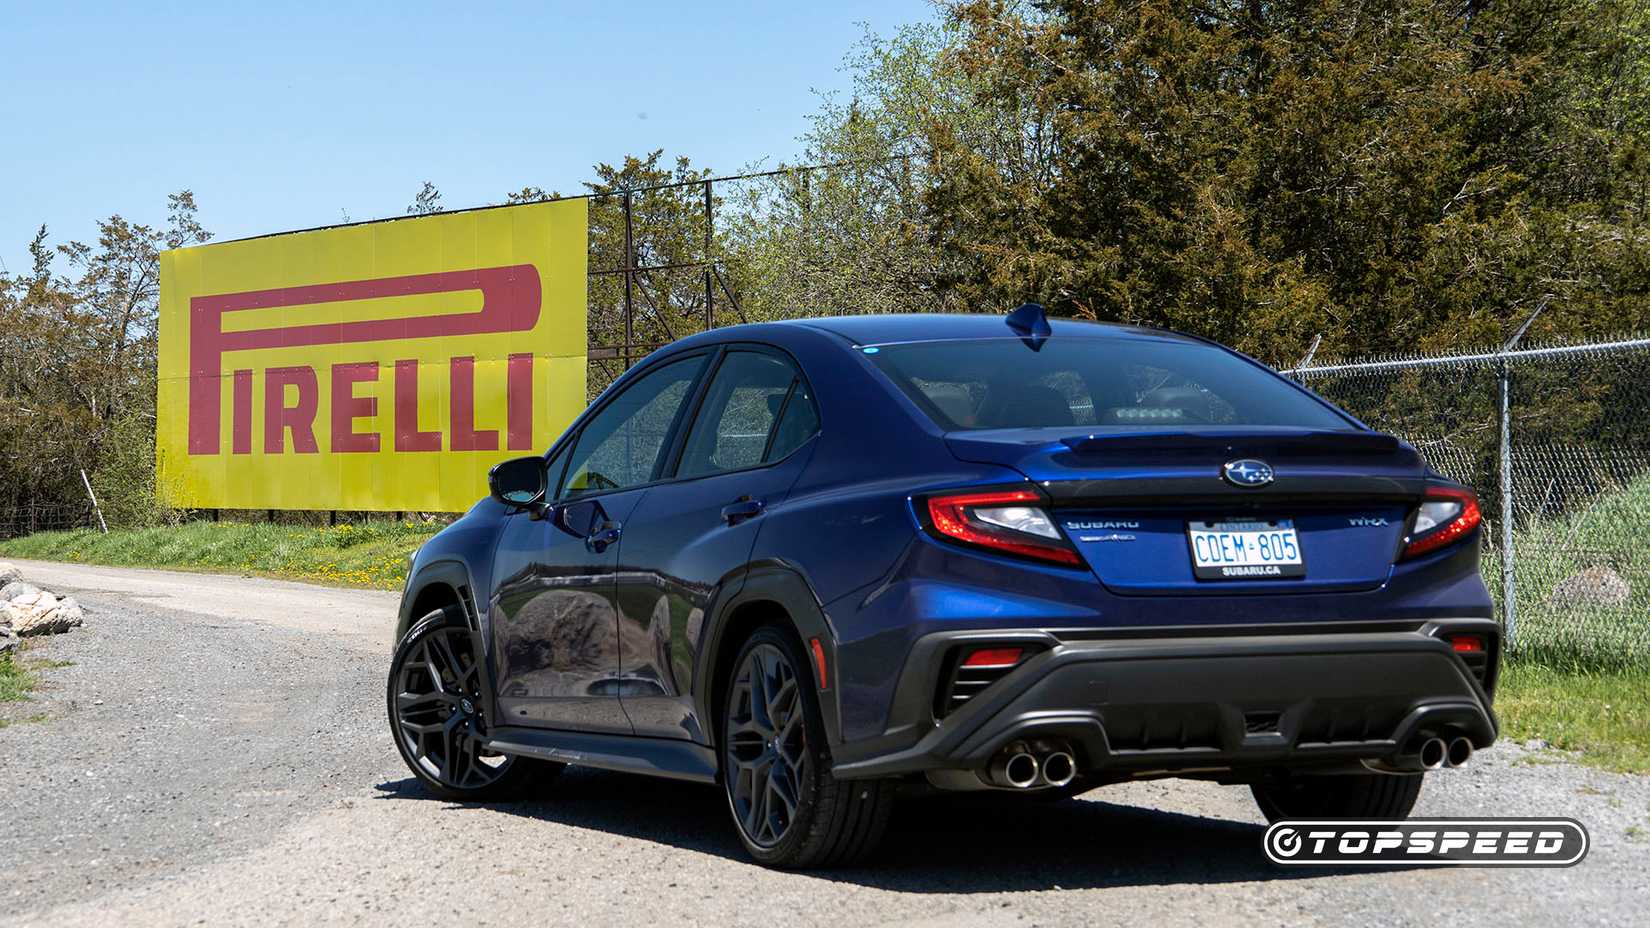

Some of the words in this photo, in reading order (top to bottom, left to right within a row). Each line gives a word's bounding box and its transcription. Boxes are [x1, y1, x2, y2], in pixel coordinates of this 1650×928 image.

[188, 264, 542, 455] PIRELLI
[1067, 521, 1139, 529] SUBARU
[1222, 566, 1281, 576] SUBARU.CA
